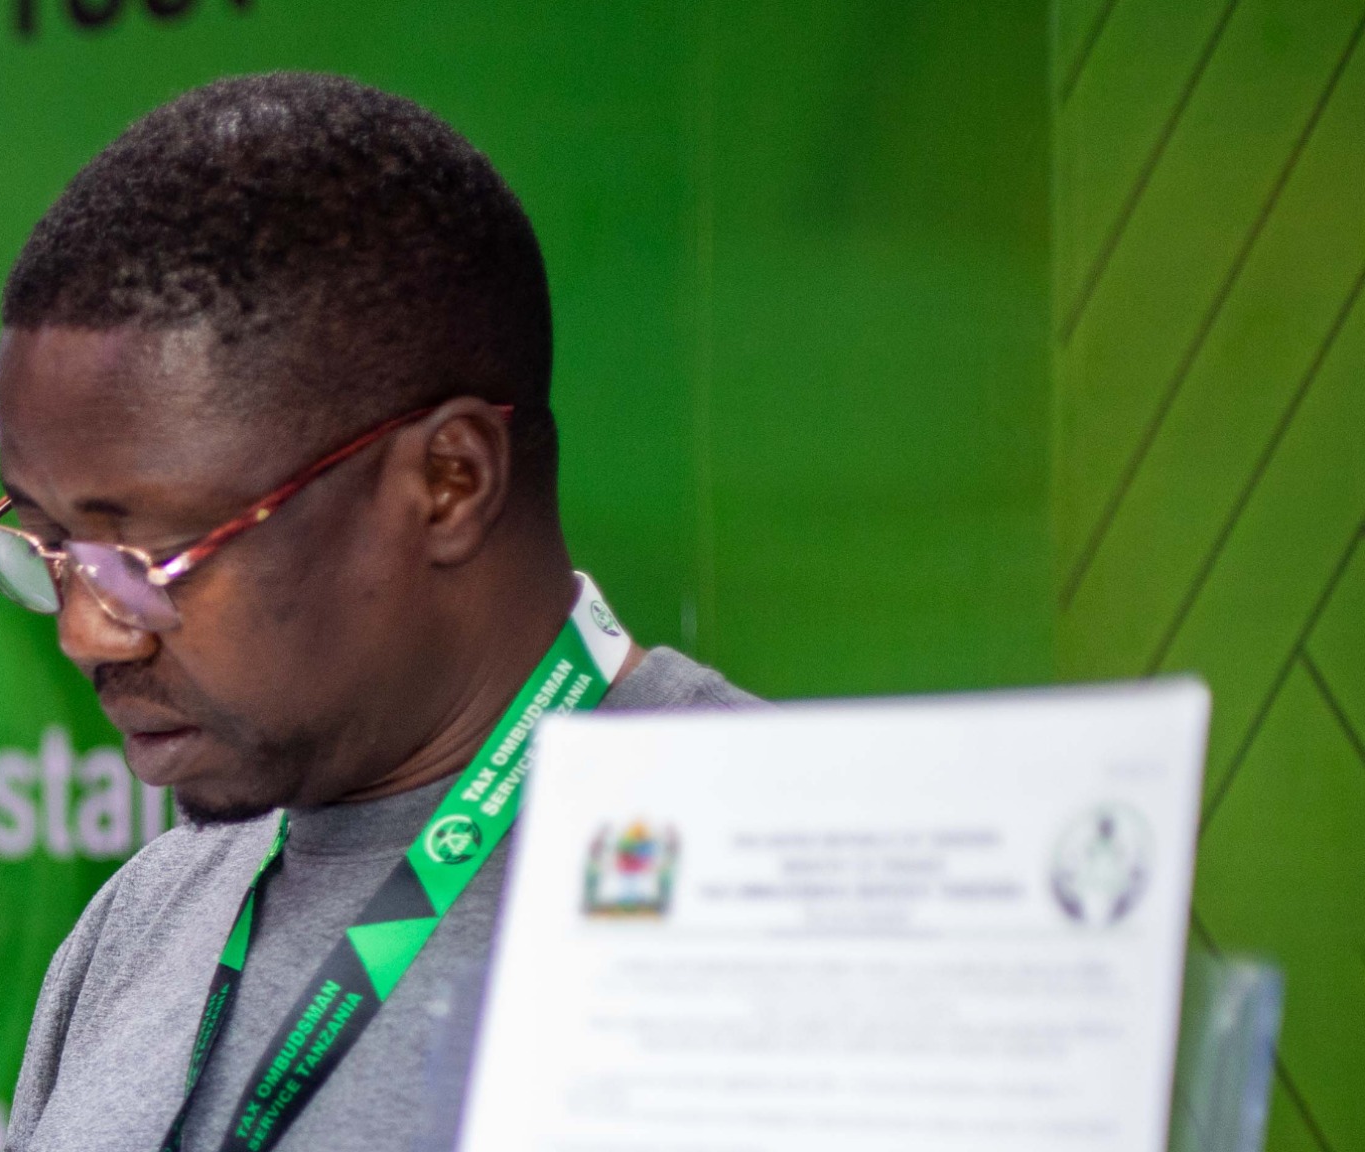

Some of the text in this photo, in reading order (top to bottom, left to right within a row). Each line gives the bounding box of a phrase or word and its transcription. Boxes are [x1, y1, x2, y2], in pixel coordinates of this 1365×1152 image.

[461, 658, 574, 803] TAX OMBUDSMAN
[235, 978, 342, 1139] TAX OMBUDSMAN
[247, 991, 365, 1152] SERVICE TANZANIA
